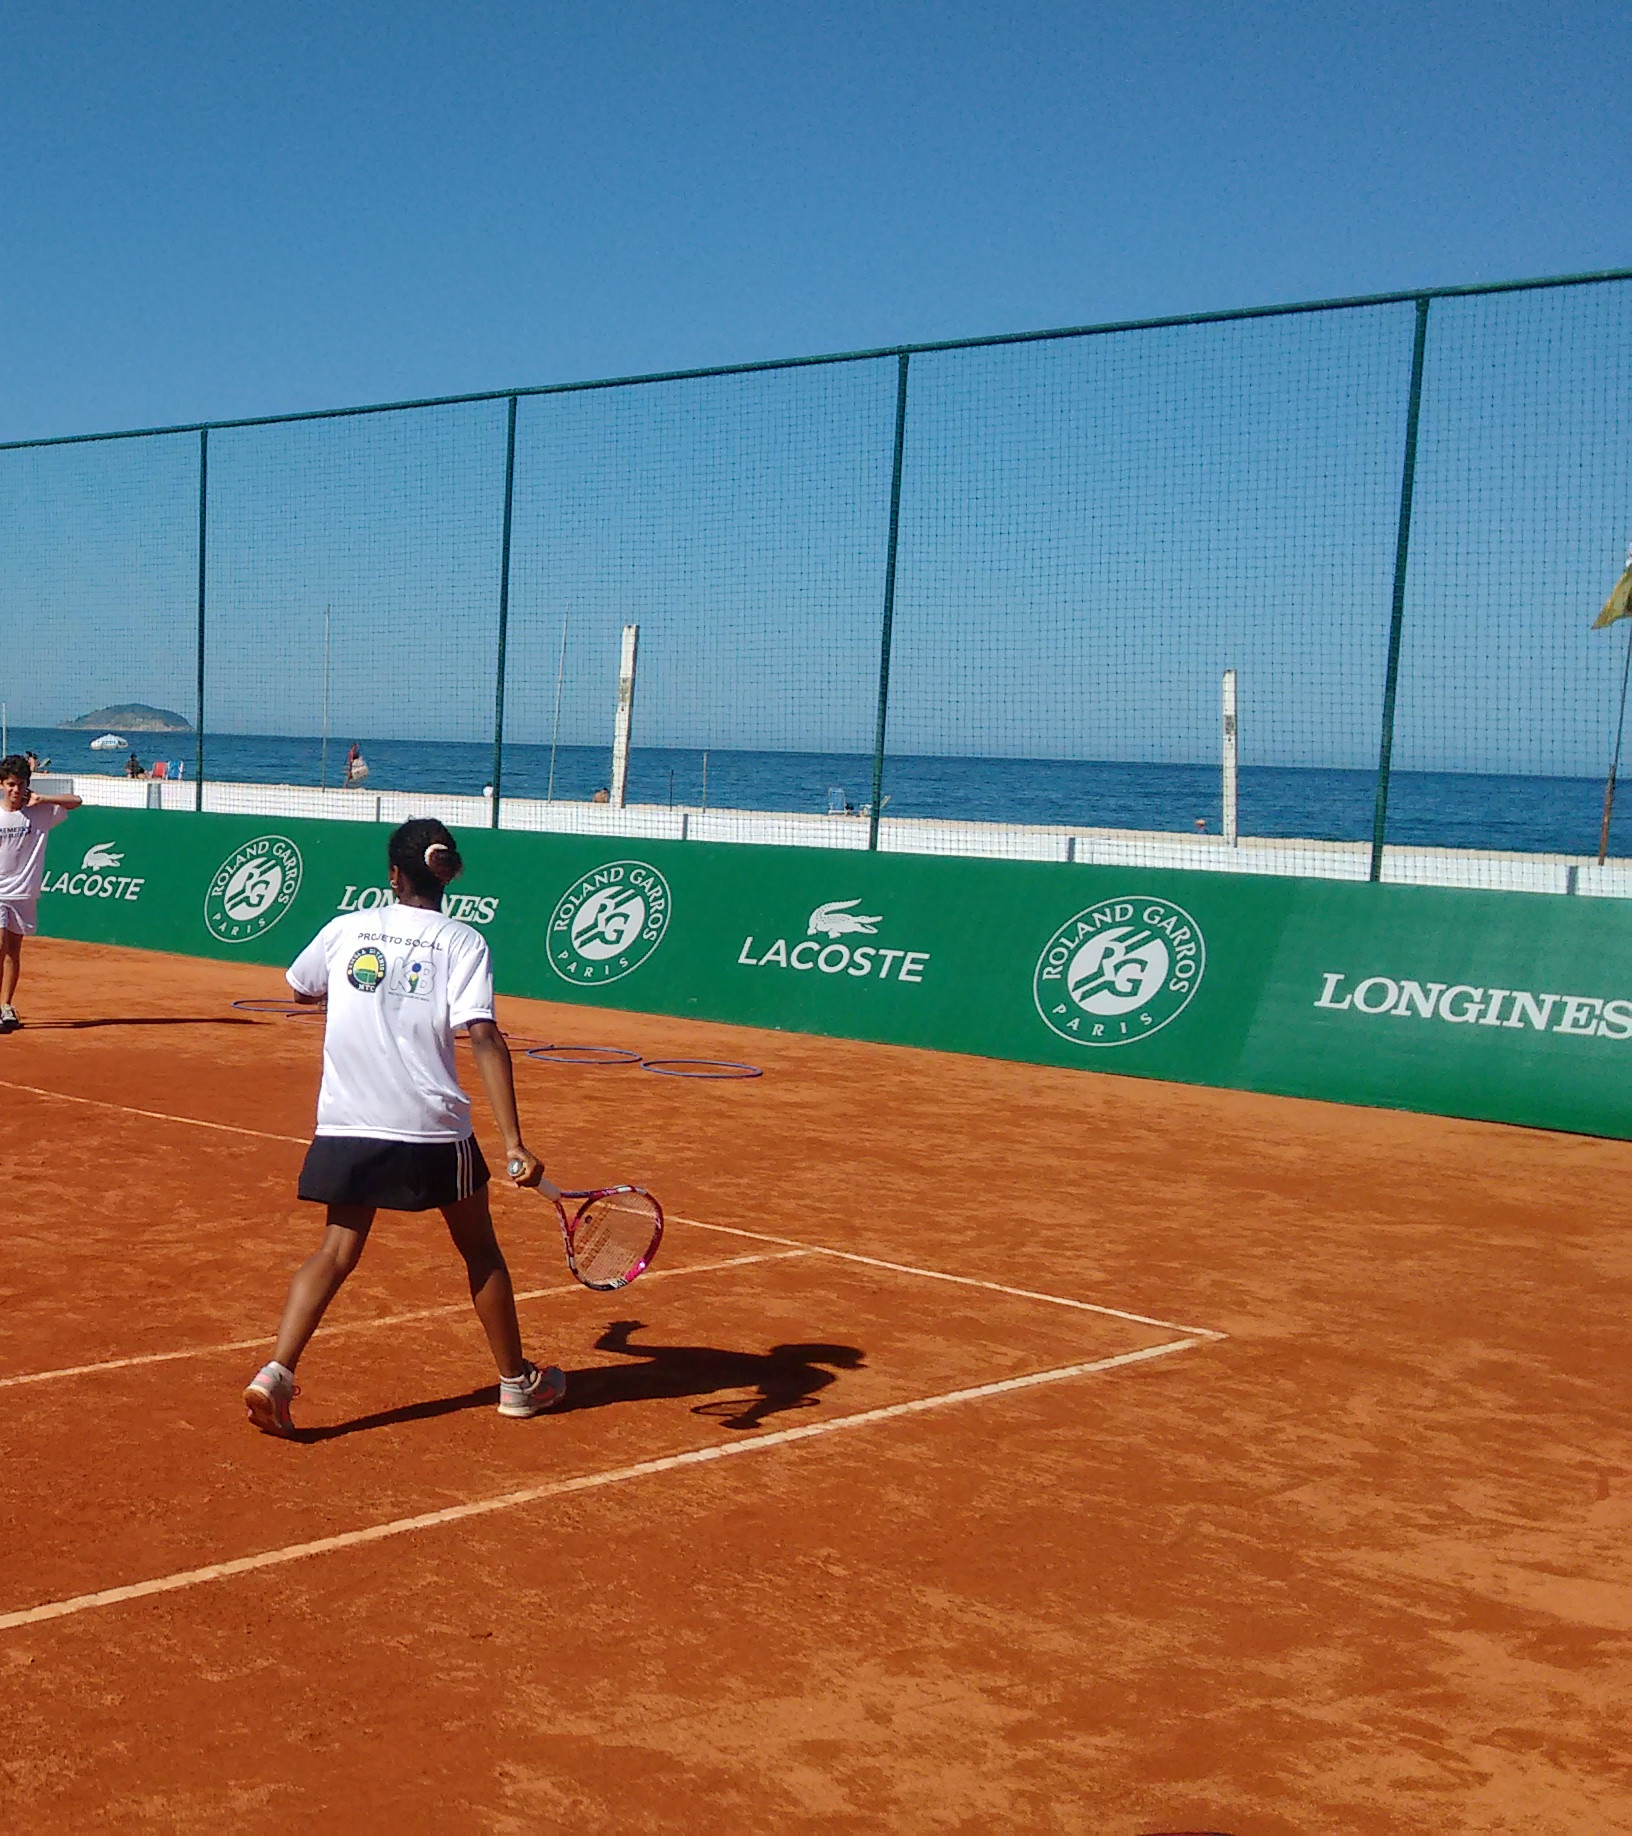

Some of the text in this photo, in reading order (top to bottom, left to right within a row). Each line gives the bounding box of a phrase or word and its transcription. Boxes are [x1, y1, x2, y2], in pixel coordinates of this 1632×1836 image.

[40, 871, 145, 900] LACOSTE
[212, 841, 297, 904] ROLAND GARROS
[554, 867, 665, 940] ROLAND GARROS
[213, 913, 265, 935] PARIS
[358, 933, 402, 945] PROJETO
[558, 950, 628, 977] PARIS
[737, 936, 930, 982] LACOSTE
[1042, 904, 1196, 993] ROLAND GARROS
[1052, 1003, 1152, 1036] PARIS
[1314, 973, 1632, 1039] LONGINES
